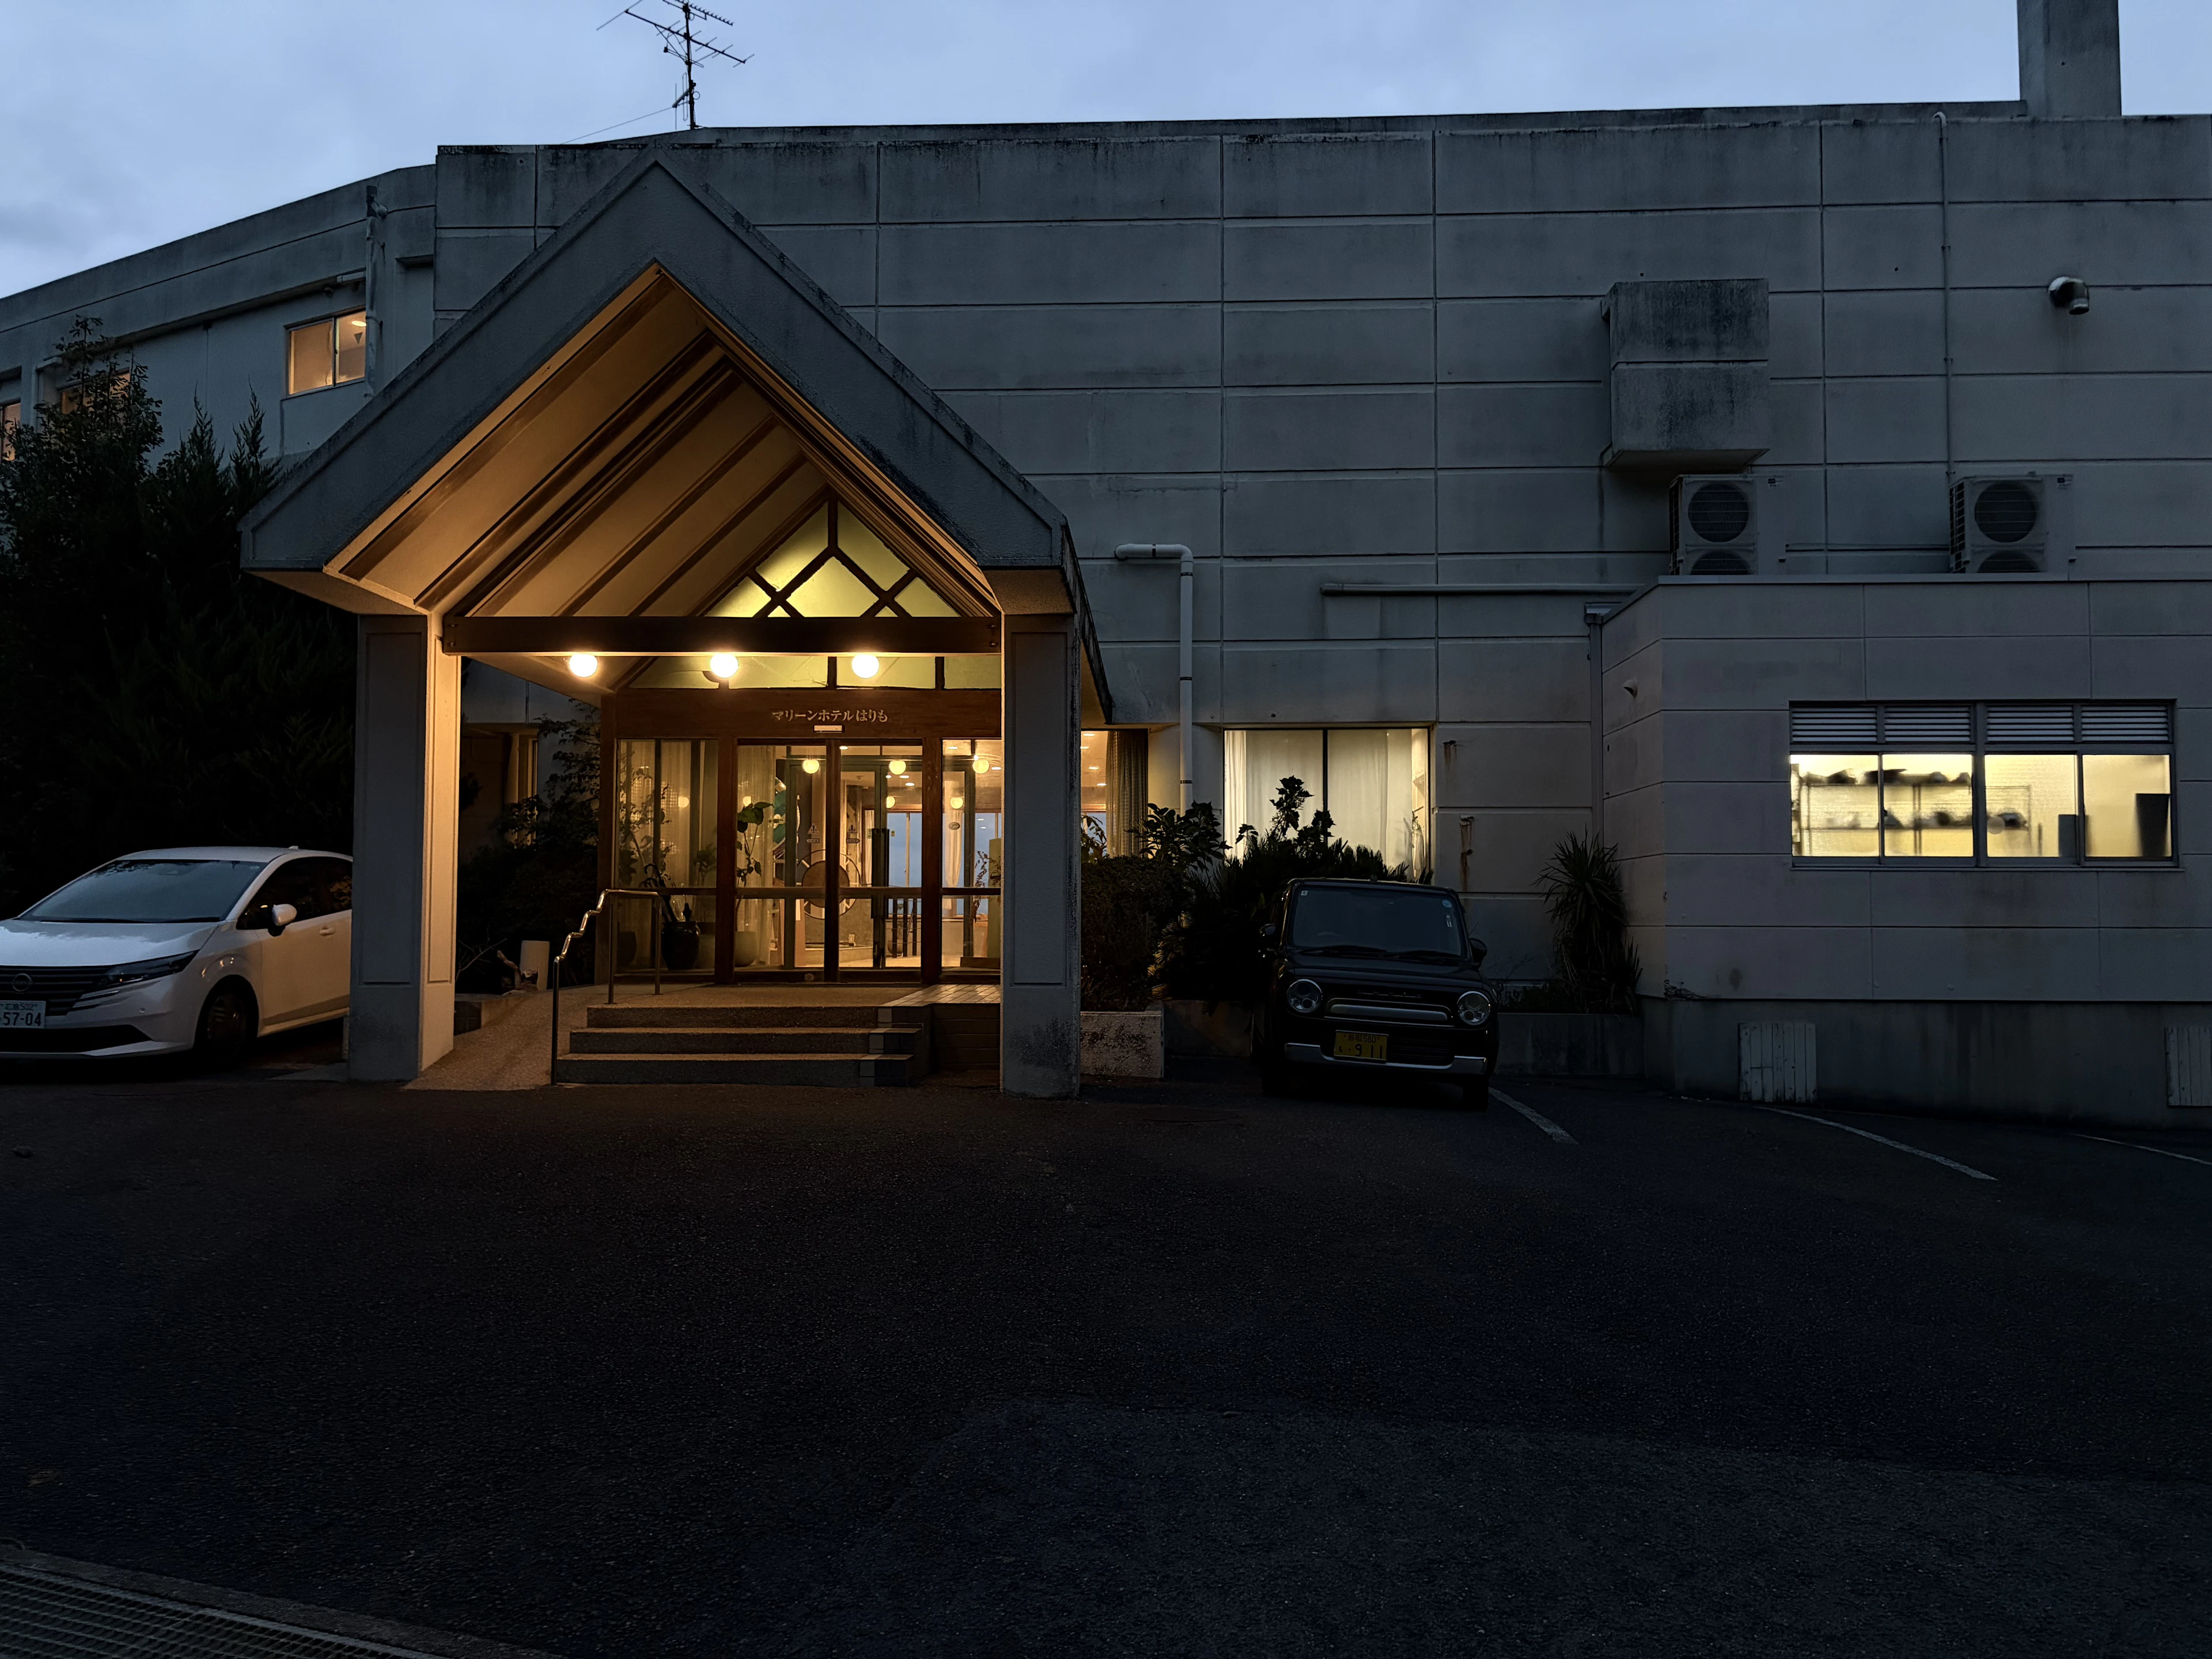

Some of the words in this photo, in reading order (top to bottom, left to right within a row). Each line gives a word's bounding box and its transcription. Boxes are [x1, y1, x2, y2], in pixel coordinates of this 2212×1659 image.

[772, 709, 888, 723] マリーンホテルはりも
[3, 1012, 41, 1026] 57-04
